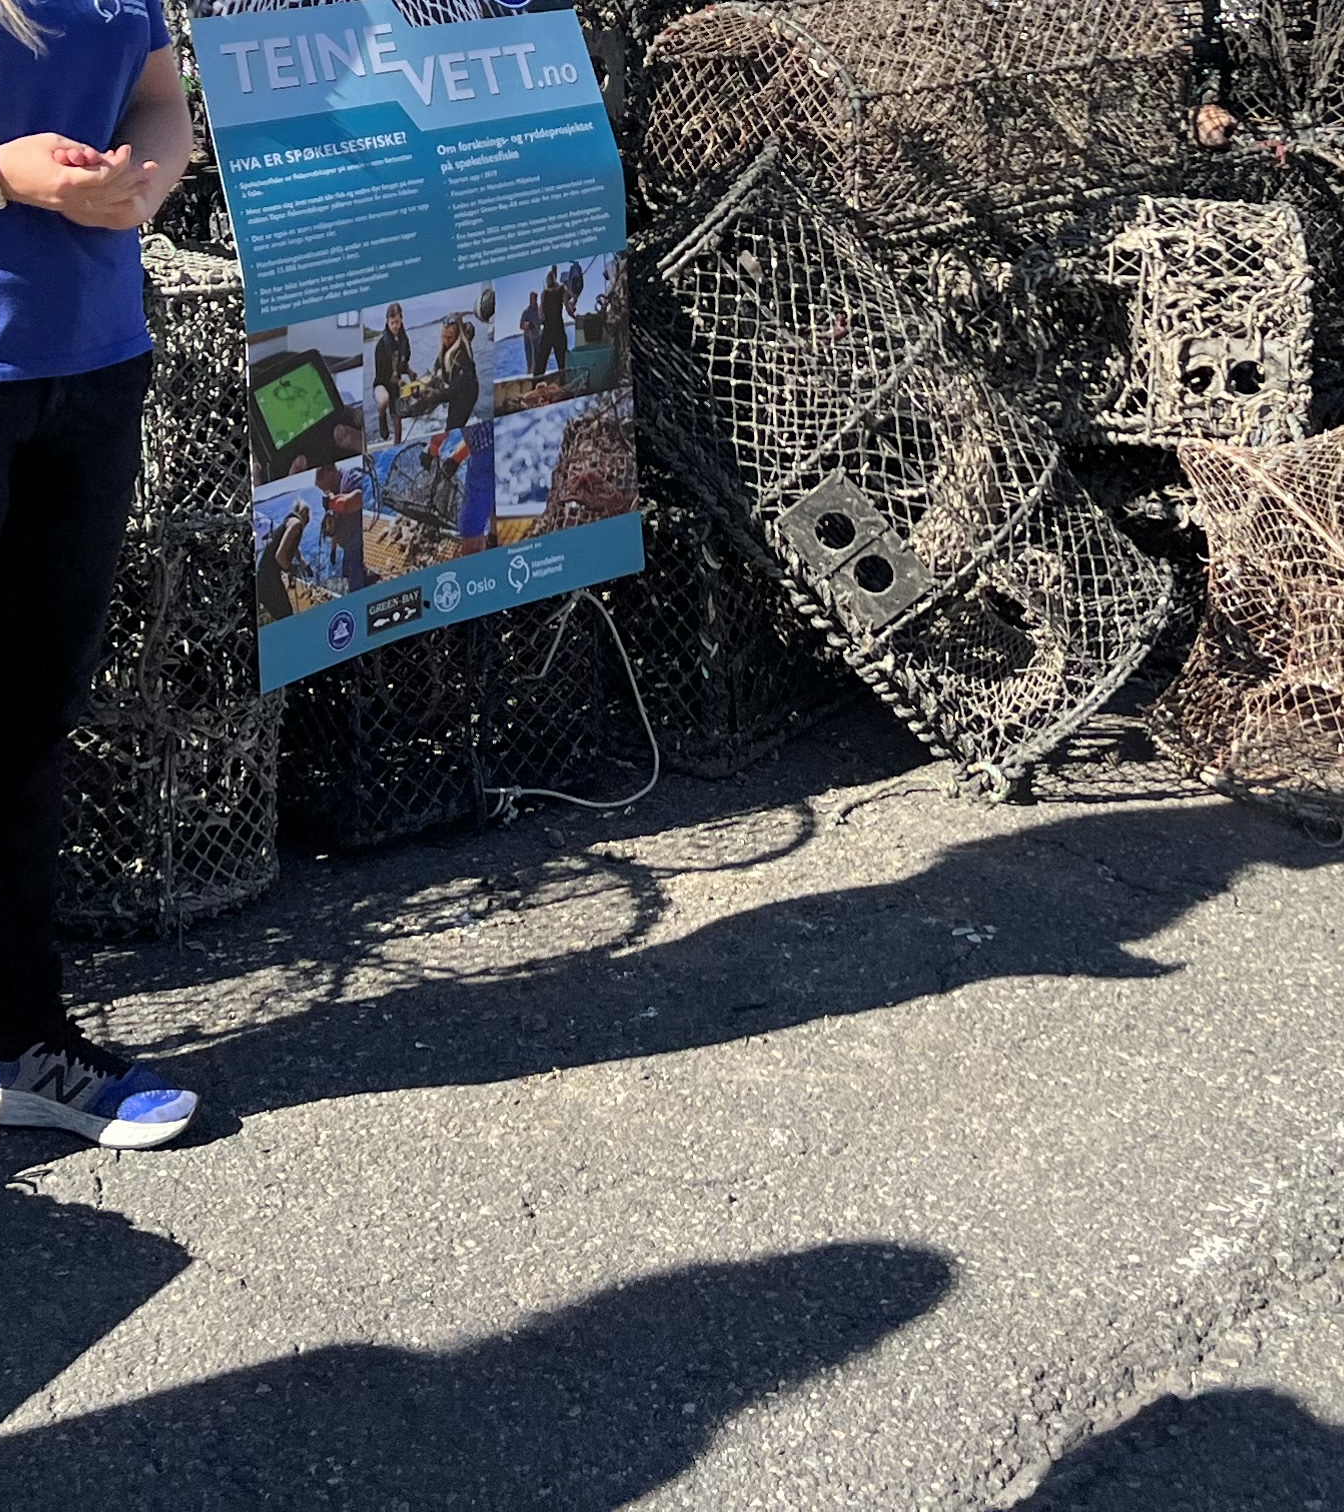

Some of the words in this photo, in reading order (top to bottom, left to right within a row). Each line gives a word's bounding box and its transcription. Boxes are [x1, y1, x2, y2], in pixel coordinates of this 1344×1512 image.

[229, 156, 262, 174] HVA
[264, 151, 284, 167] ER
[284, 131, 408, 163] SPØKELSESFISKE?
[436, 143, 457, 156] Om
[511, 133, 524, 145] og
[440, 159, 454, 175] på
[466, 576, 497, 596] Oslo
